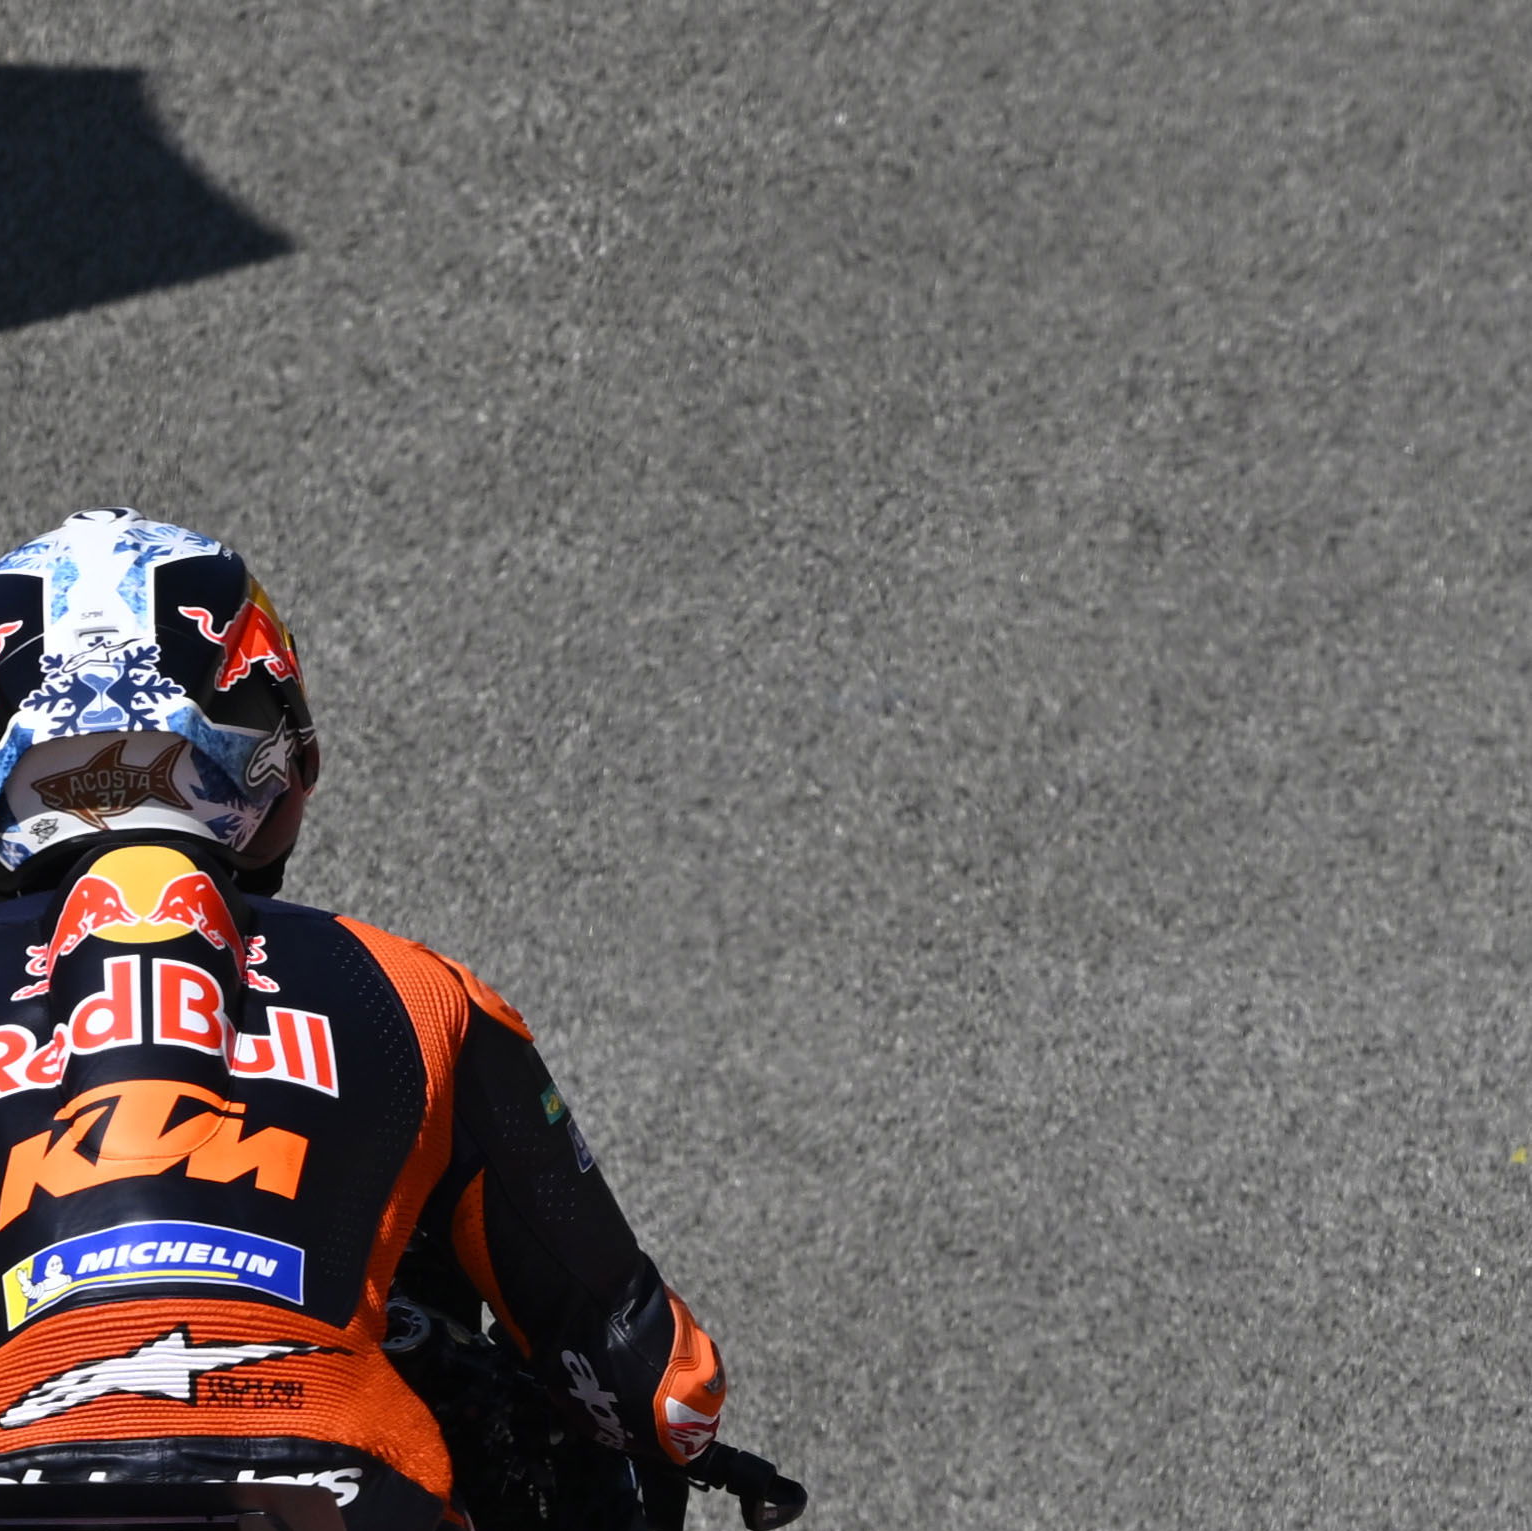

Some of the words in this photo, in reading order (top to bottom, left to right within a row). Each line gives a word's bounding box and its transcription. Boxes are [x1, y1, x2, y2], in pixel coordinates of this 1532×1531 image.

[70, 769, 151, 797] ACOSTA
[96, 789, 127, 812] 37
[152, 957, 339, 1098] Bull
[75, 1241, 279, 1278] MICHELIN
